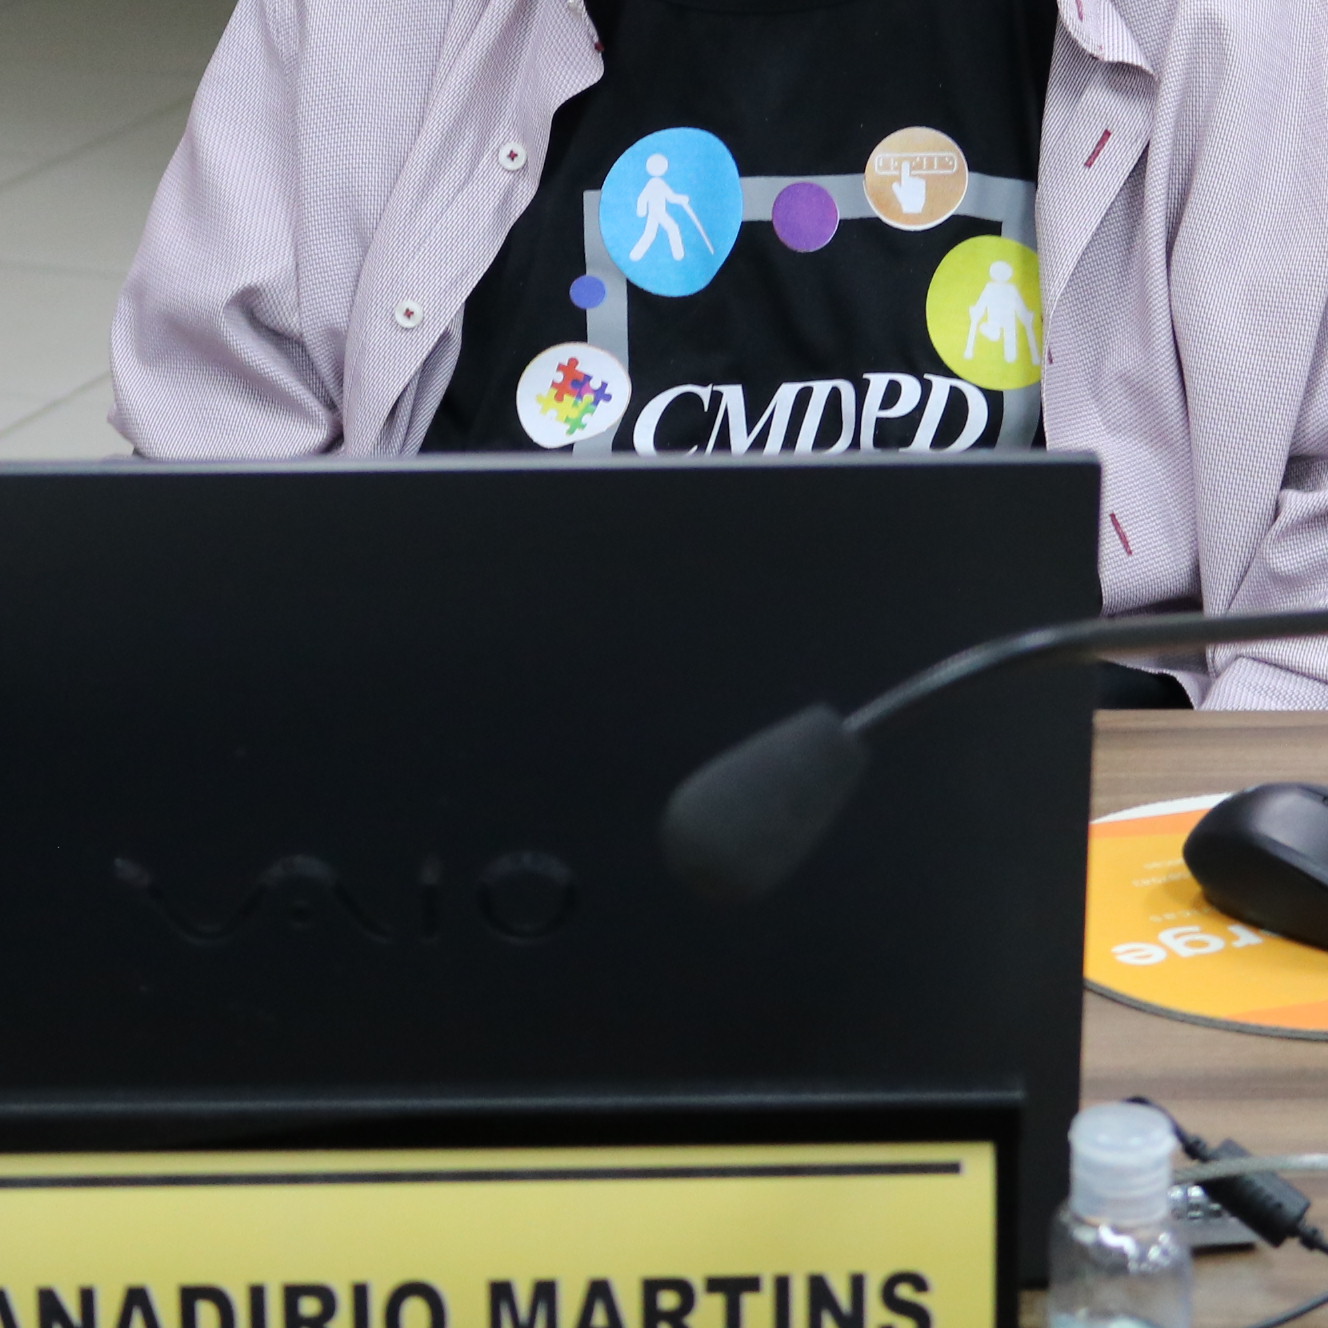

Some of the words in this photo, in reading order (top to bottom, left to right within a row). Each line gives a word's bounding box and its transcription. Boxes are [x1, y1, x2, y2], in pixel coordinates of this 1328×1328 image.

[632, 372, 989, 457] CMDPD
[113, 850, 578, 945] VAIO
[487, 1270, 934, 1328] MARTINS
